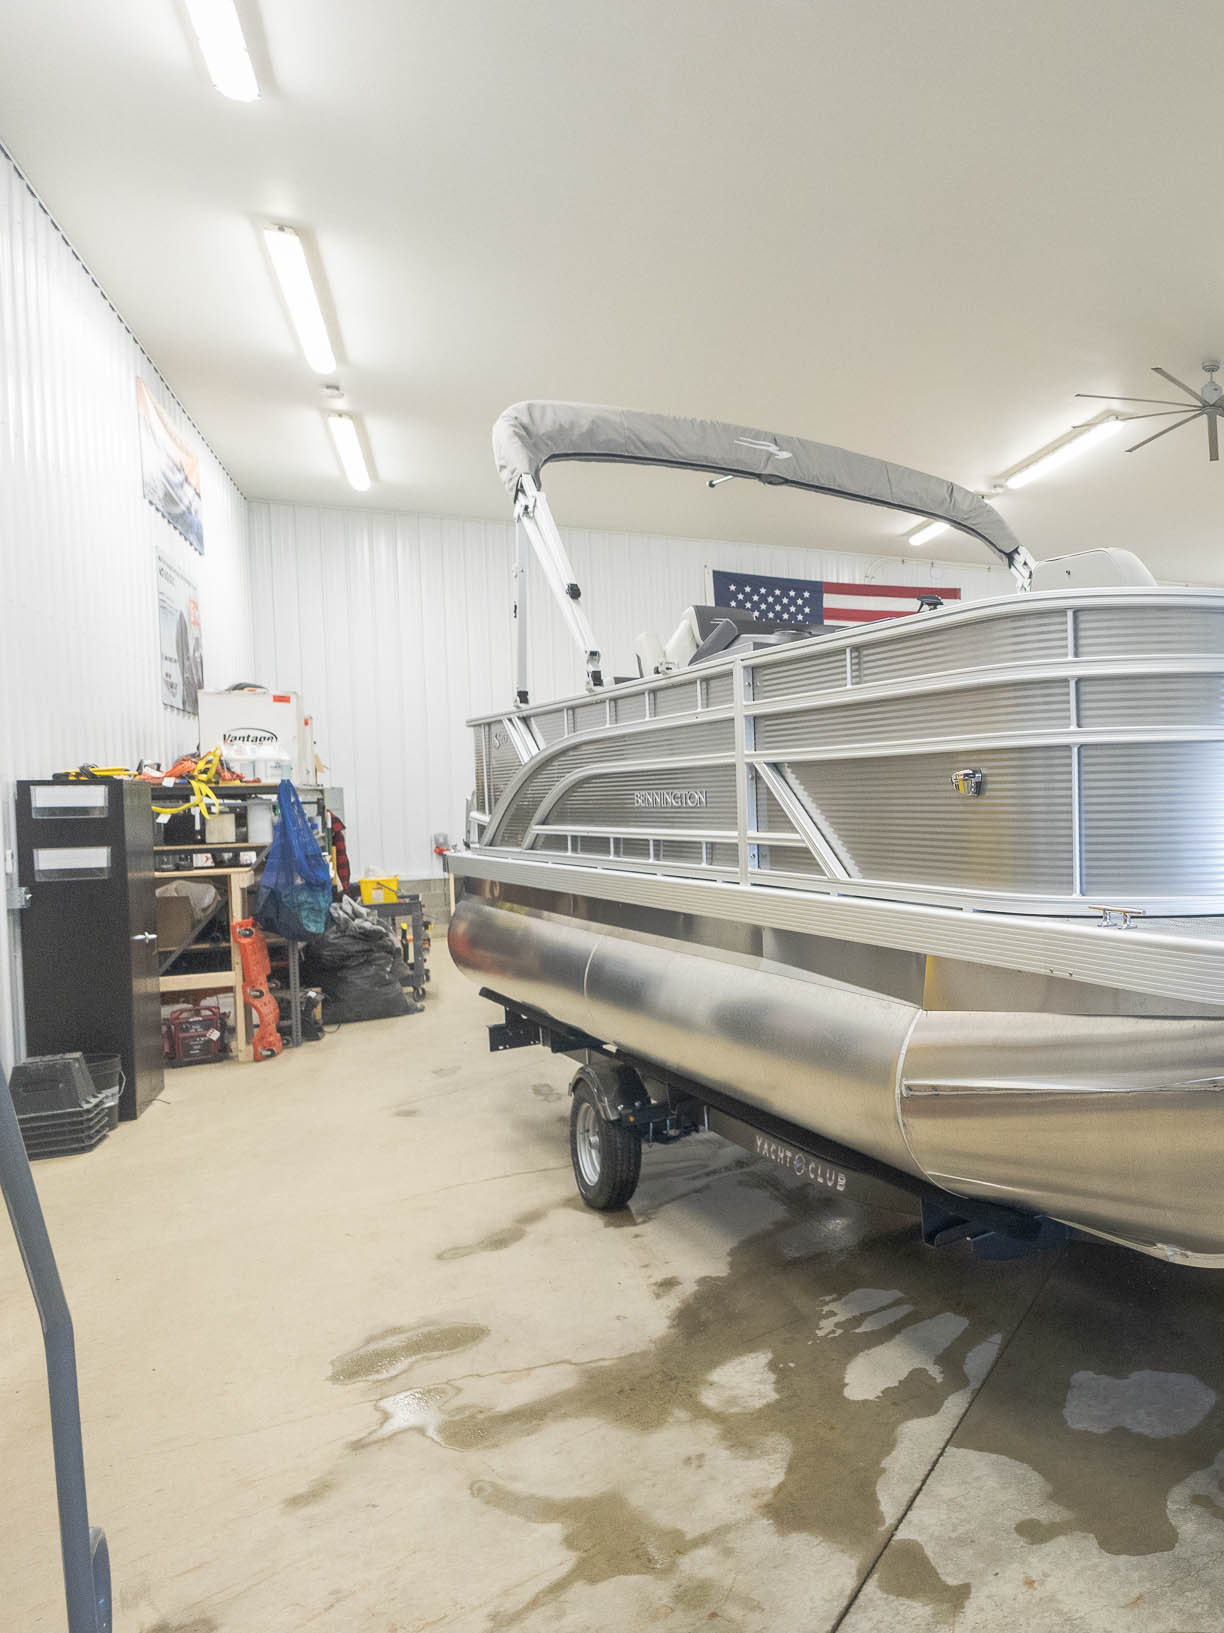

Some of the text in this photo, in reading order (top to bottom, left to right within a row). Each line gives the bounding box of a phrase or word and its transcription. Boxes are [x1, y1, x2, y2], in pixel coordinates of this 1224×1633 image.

[223, 733, 274, 744] Vantage
[634, 790, 707, 808] BENNINGTON
[756, 1135, 847, 1191] YACHT CLUB
